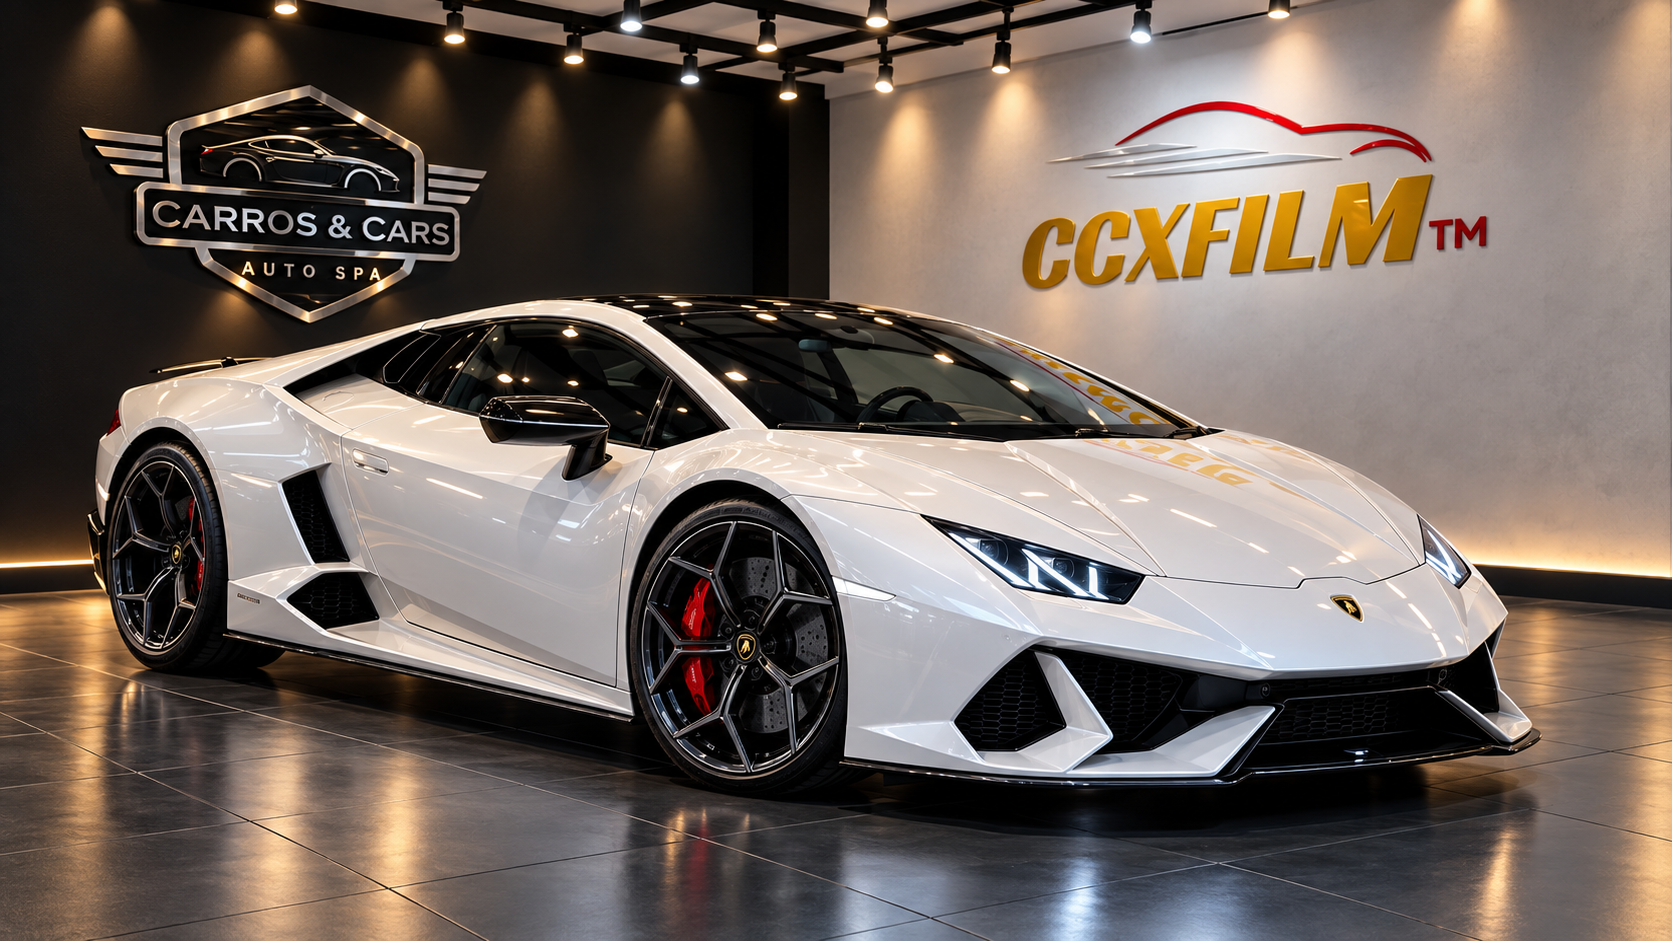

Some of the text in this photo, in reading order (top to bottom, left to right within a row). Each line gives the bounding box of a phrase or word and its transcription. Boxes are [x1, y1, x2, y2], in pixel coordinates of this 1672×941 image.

[152, 200, 450, 245] CARROS & CARS
[1022, 174, 1434, 289] CCXFILM
[241, 260, 381, 281] AUTO SPA
